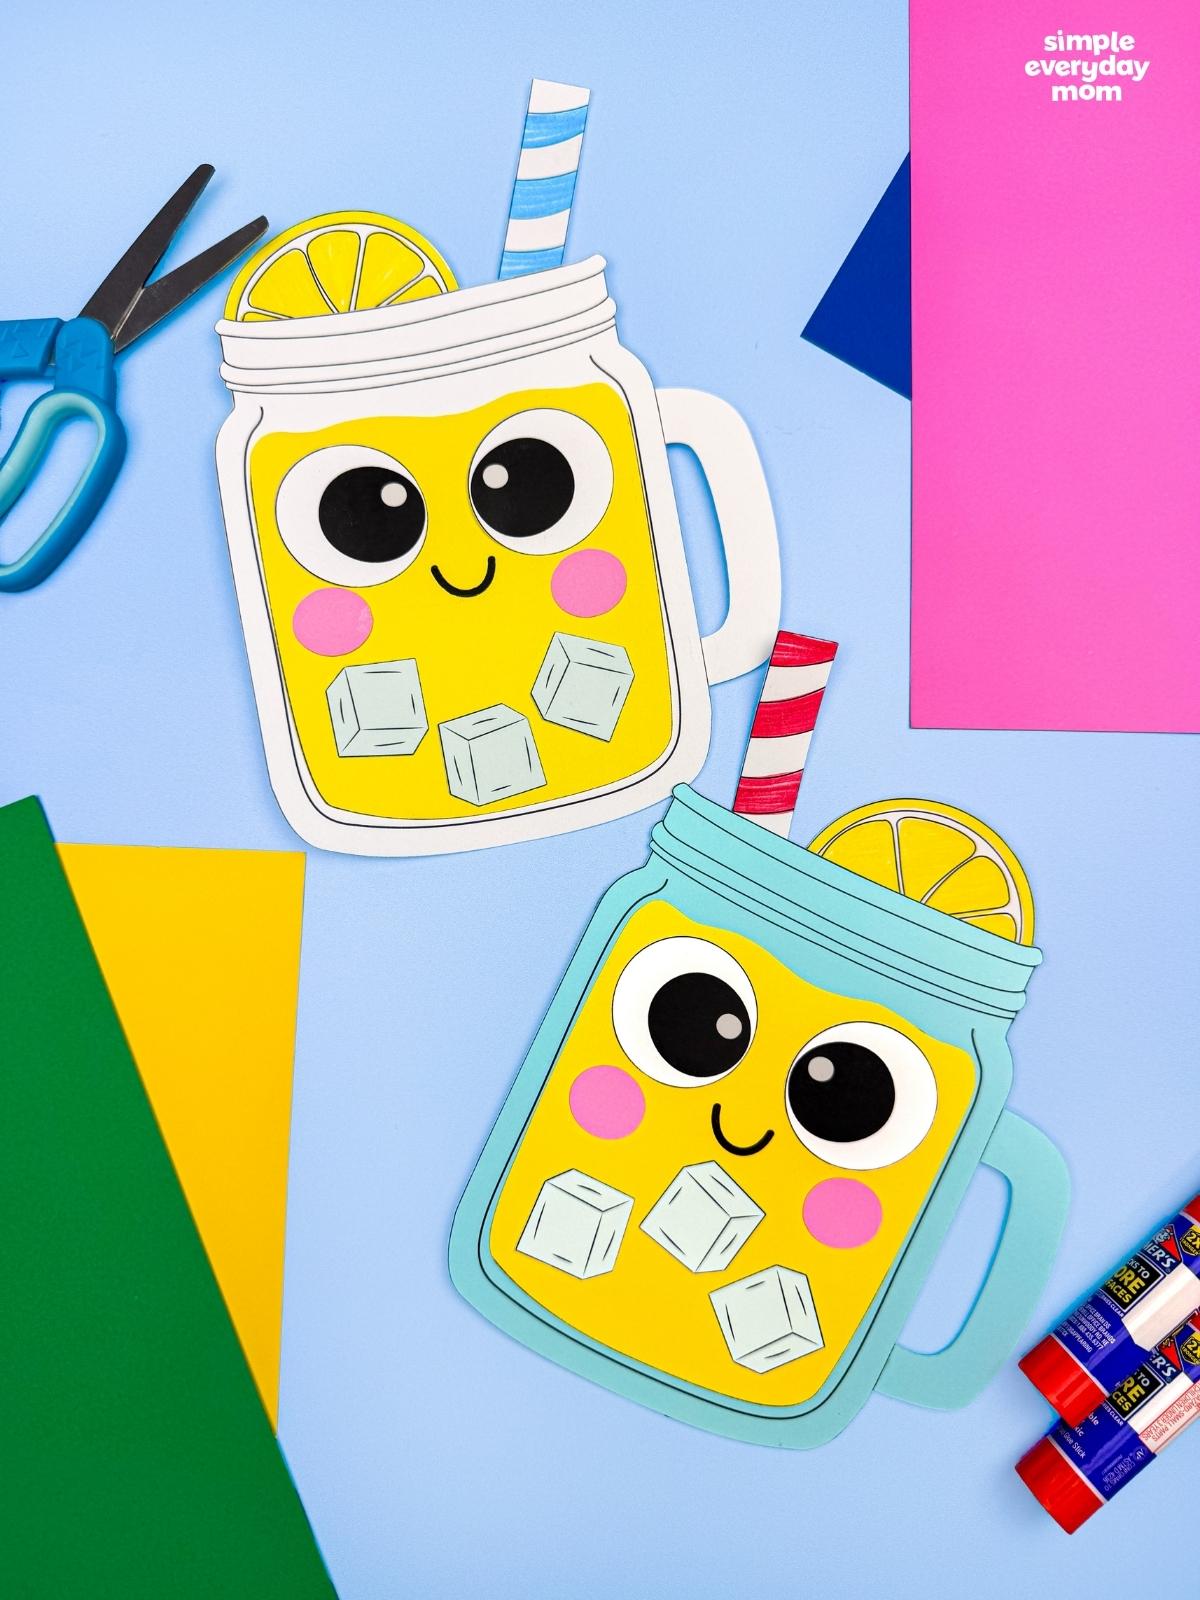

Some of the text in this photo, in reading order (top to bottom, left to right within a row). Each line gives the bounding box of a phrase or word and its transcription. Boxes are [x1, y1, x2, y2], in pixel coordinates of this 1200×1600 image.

[1136, 1265, 1151, 1279] TO
[1135, 1372, 1151, 1388] TO
[1108, 1410, 1124, 1426] CLEAR
[1071, 1441, 1087, 1459] Stick
